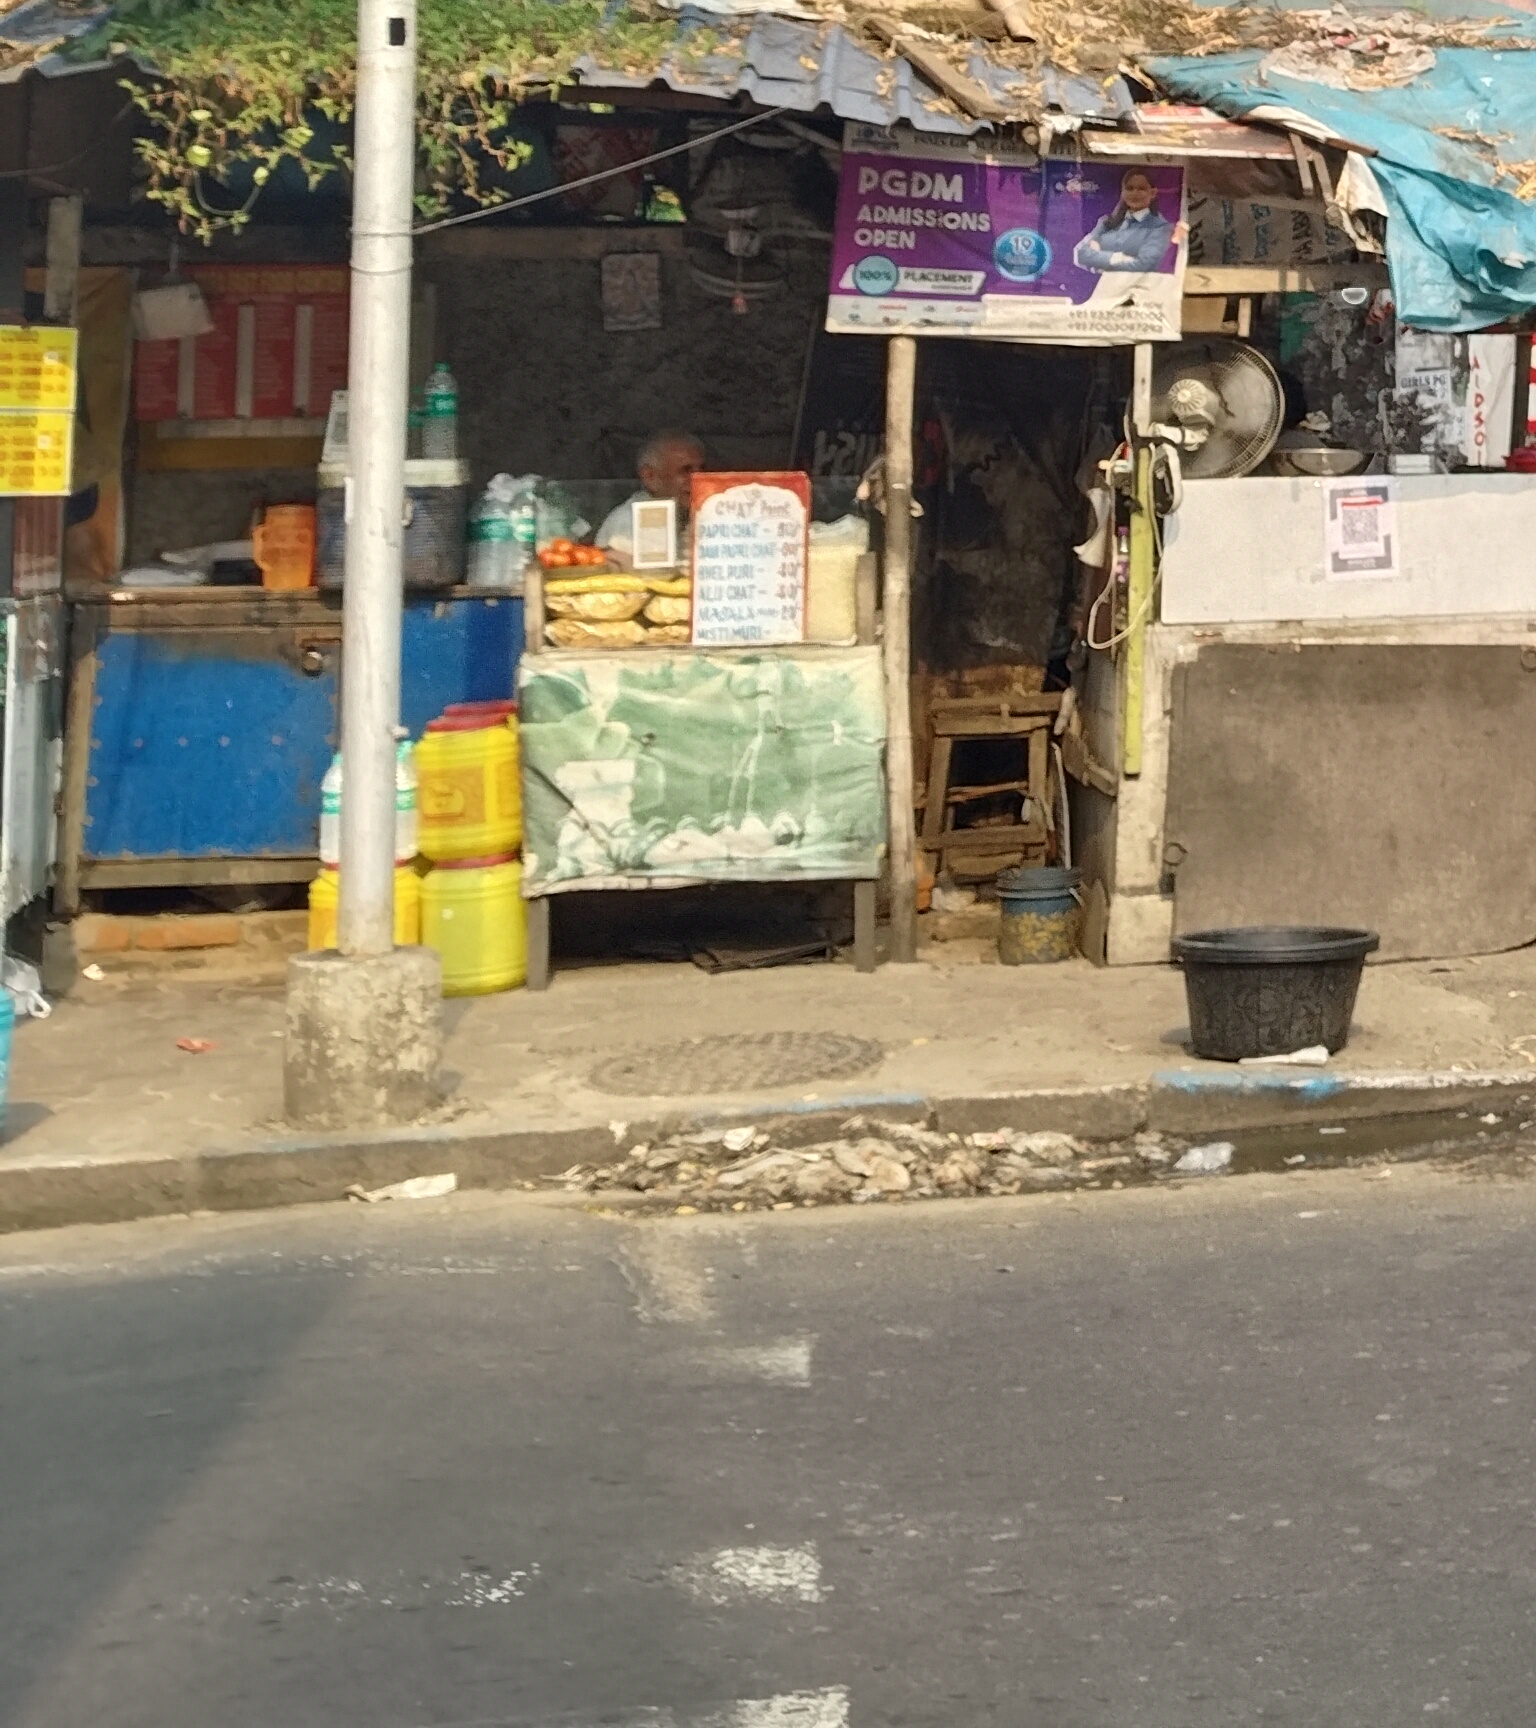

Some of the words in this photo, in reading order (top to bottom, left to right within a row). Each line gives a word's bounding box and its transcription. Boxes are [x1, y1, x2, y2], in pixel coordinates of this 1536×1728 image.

[857, 166, 965, 203] PGDM
[857, 203, 992, 233] ADMISSIONS
[853, 227, 917, 251] OPEN
[902, 271, 975, 285] PLACEMENT
